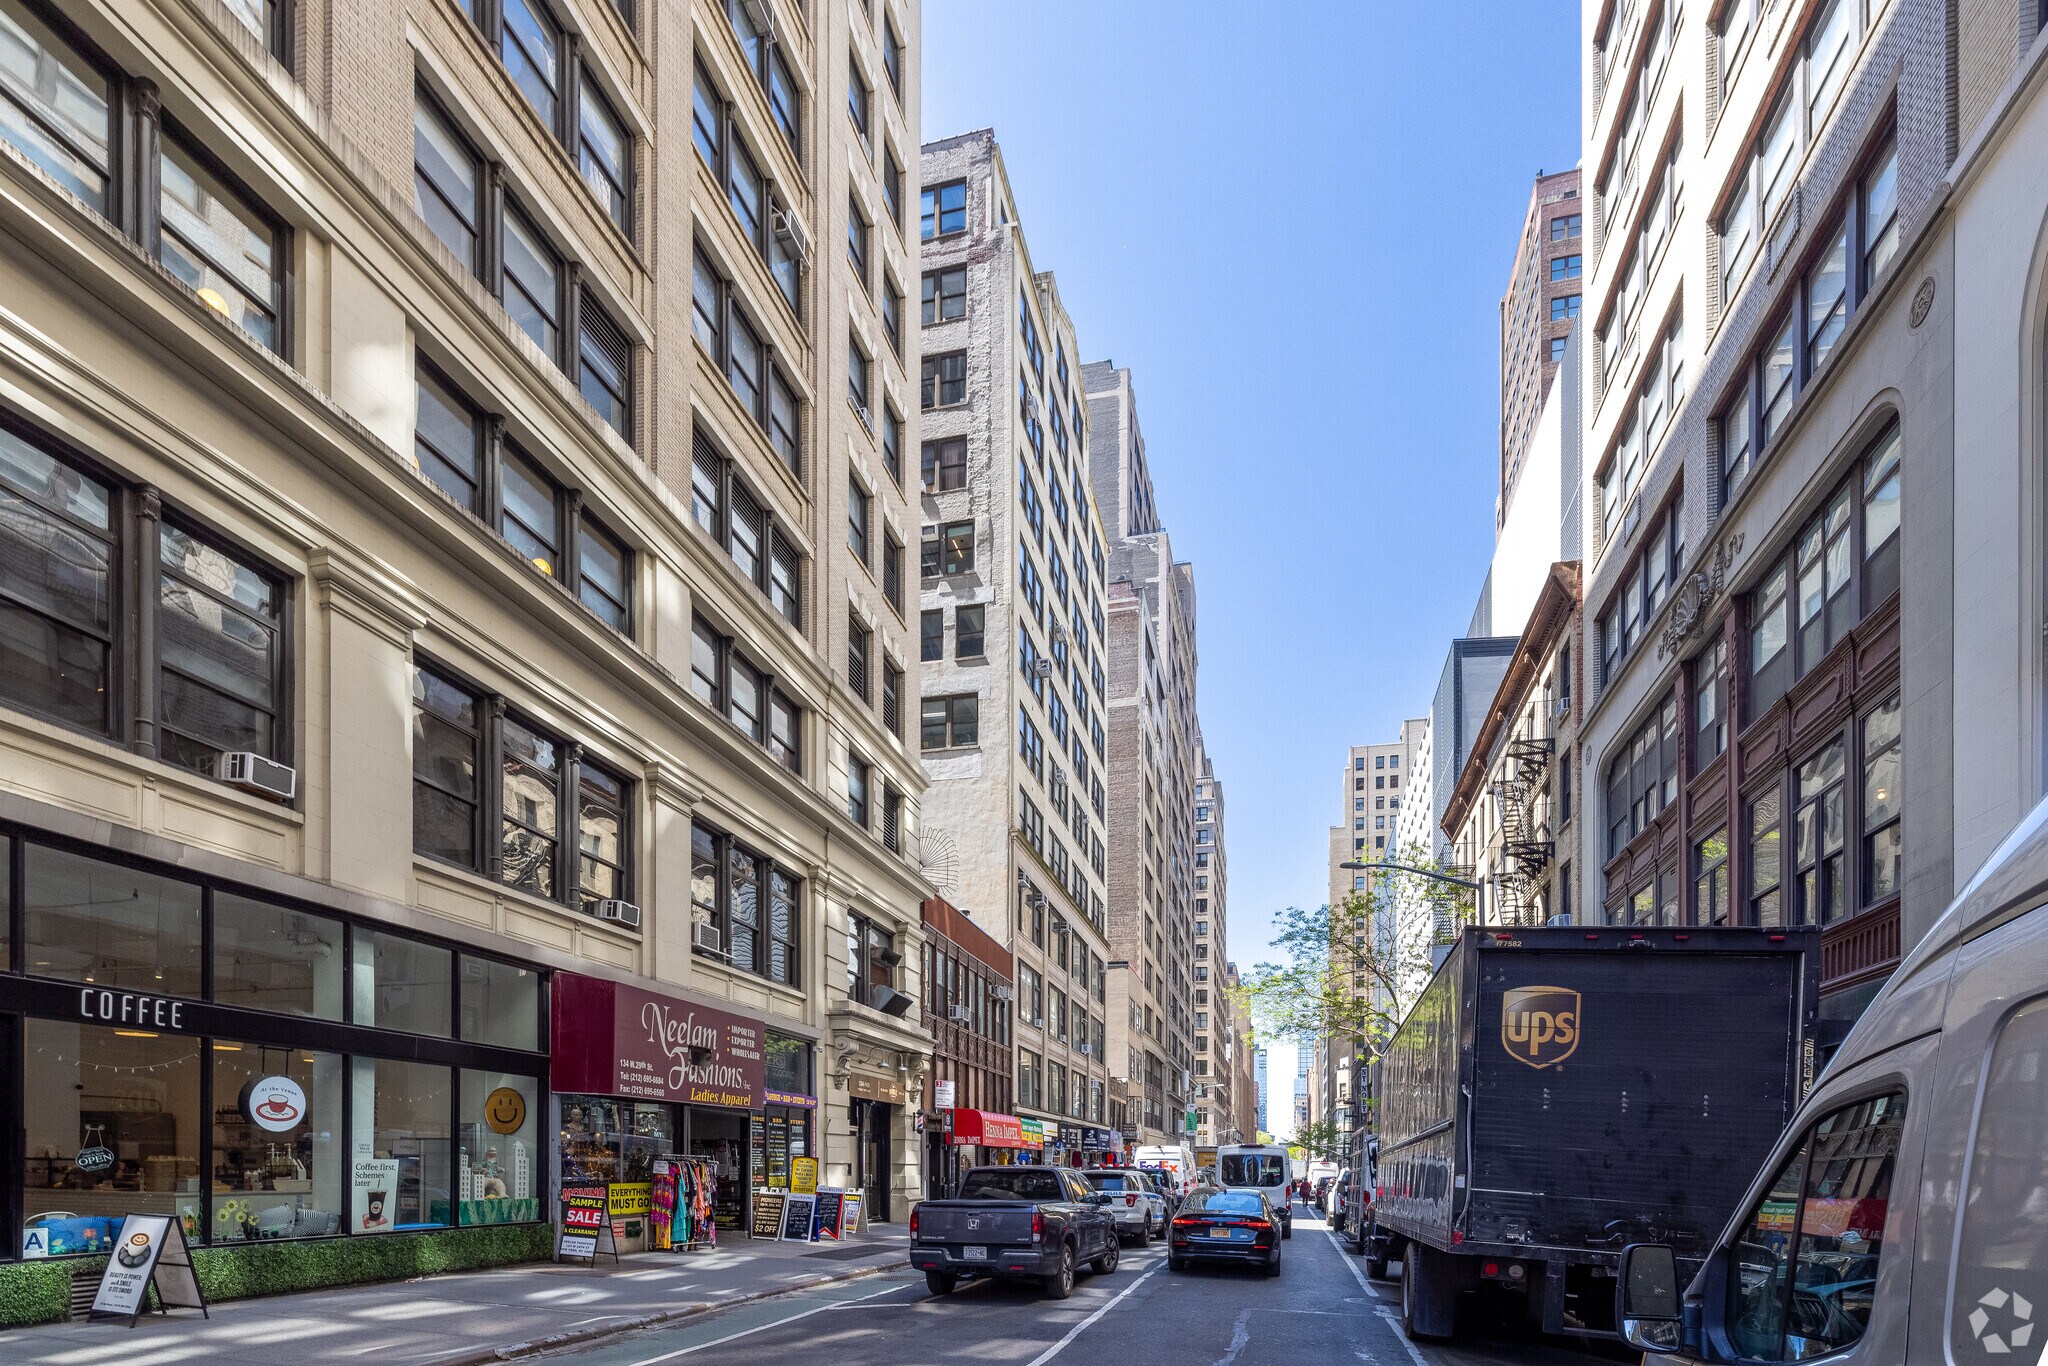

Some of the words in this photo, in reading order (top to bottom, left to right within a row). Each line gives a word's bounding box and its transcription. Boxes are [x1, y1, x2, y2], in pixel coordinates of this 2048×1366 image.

[81, 989, 183, 1029] COFFEE
[641, 1002, 718, 1057] Neelam
[731, 1025, 756, 1038] IMPORTER
[1507, 1011, 1575, 1056] ups
[731, 1036, 756, 1049] EXPORTER
[731, 1047, 761, 1061] WHOLESALER
[620, 1059, 629, 1068] 134
[620, 1071, 630, 1080] Tel:
[630, 1073, 643, 1083] (212)
[620, 1084, 631, 1094] Fax:
[631, 1085, 644, 1095] (212)
[690, 1087, 719, 1103] Ladies
[720, 1091, 751, 1107] Apparel
[984, 1121, 1003, 1139] HENNA
[78, 1153, 112, 1166] OPEN
[355, 1163, 378, 1171] Coffee
[354, 1179, 371, 1187] later
[611, 1188, 652, 1197] EVERYTHING
[569, 1198, 603, 1208] SAMPLE
[611, 1198, 636, 1210] MUST
[566, 1210, 602, 1225] SALE
[568, 1228, 598, 1236] CLEARANCE
[764, 1225, 777, 1233] OFF
[25, 1232, 43, 1250] A
